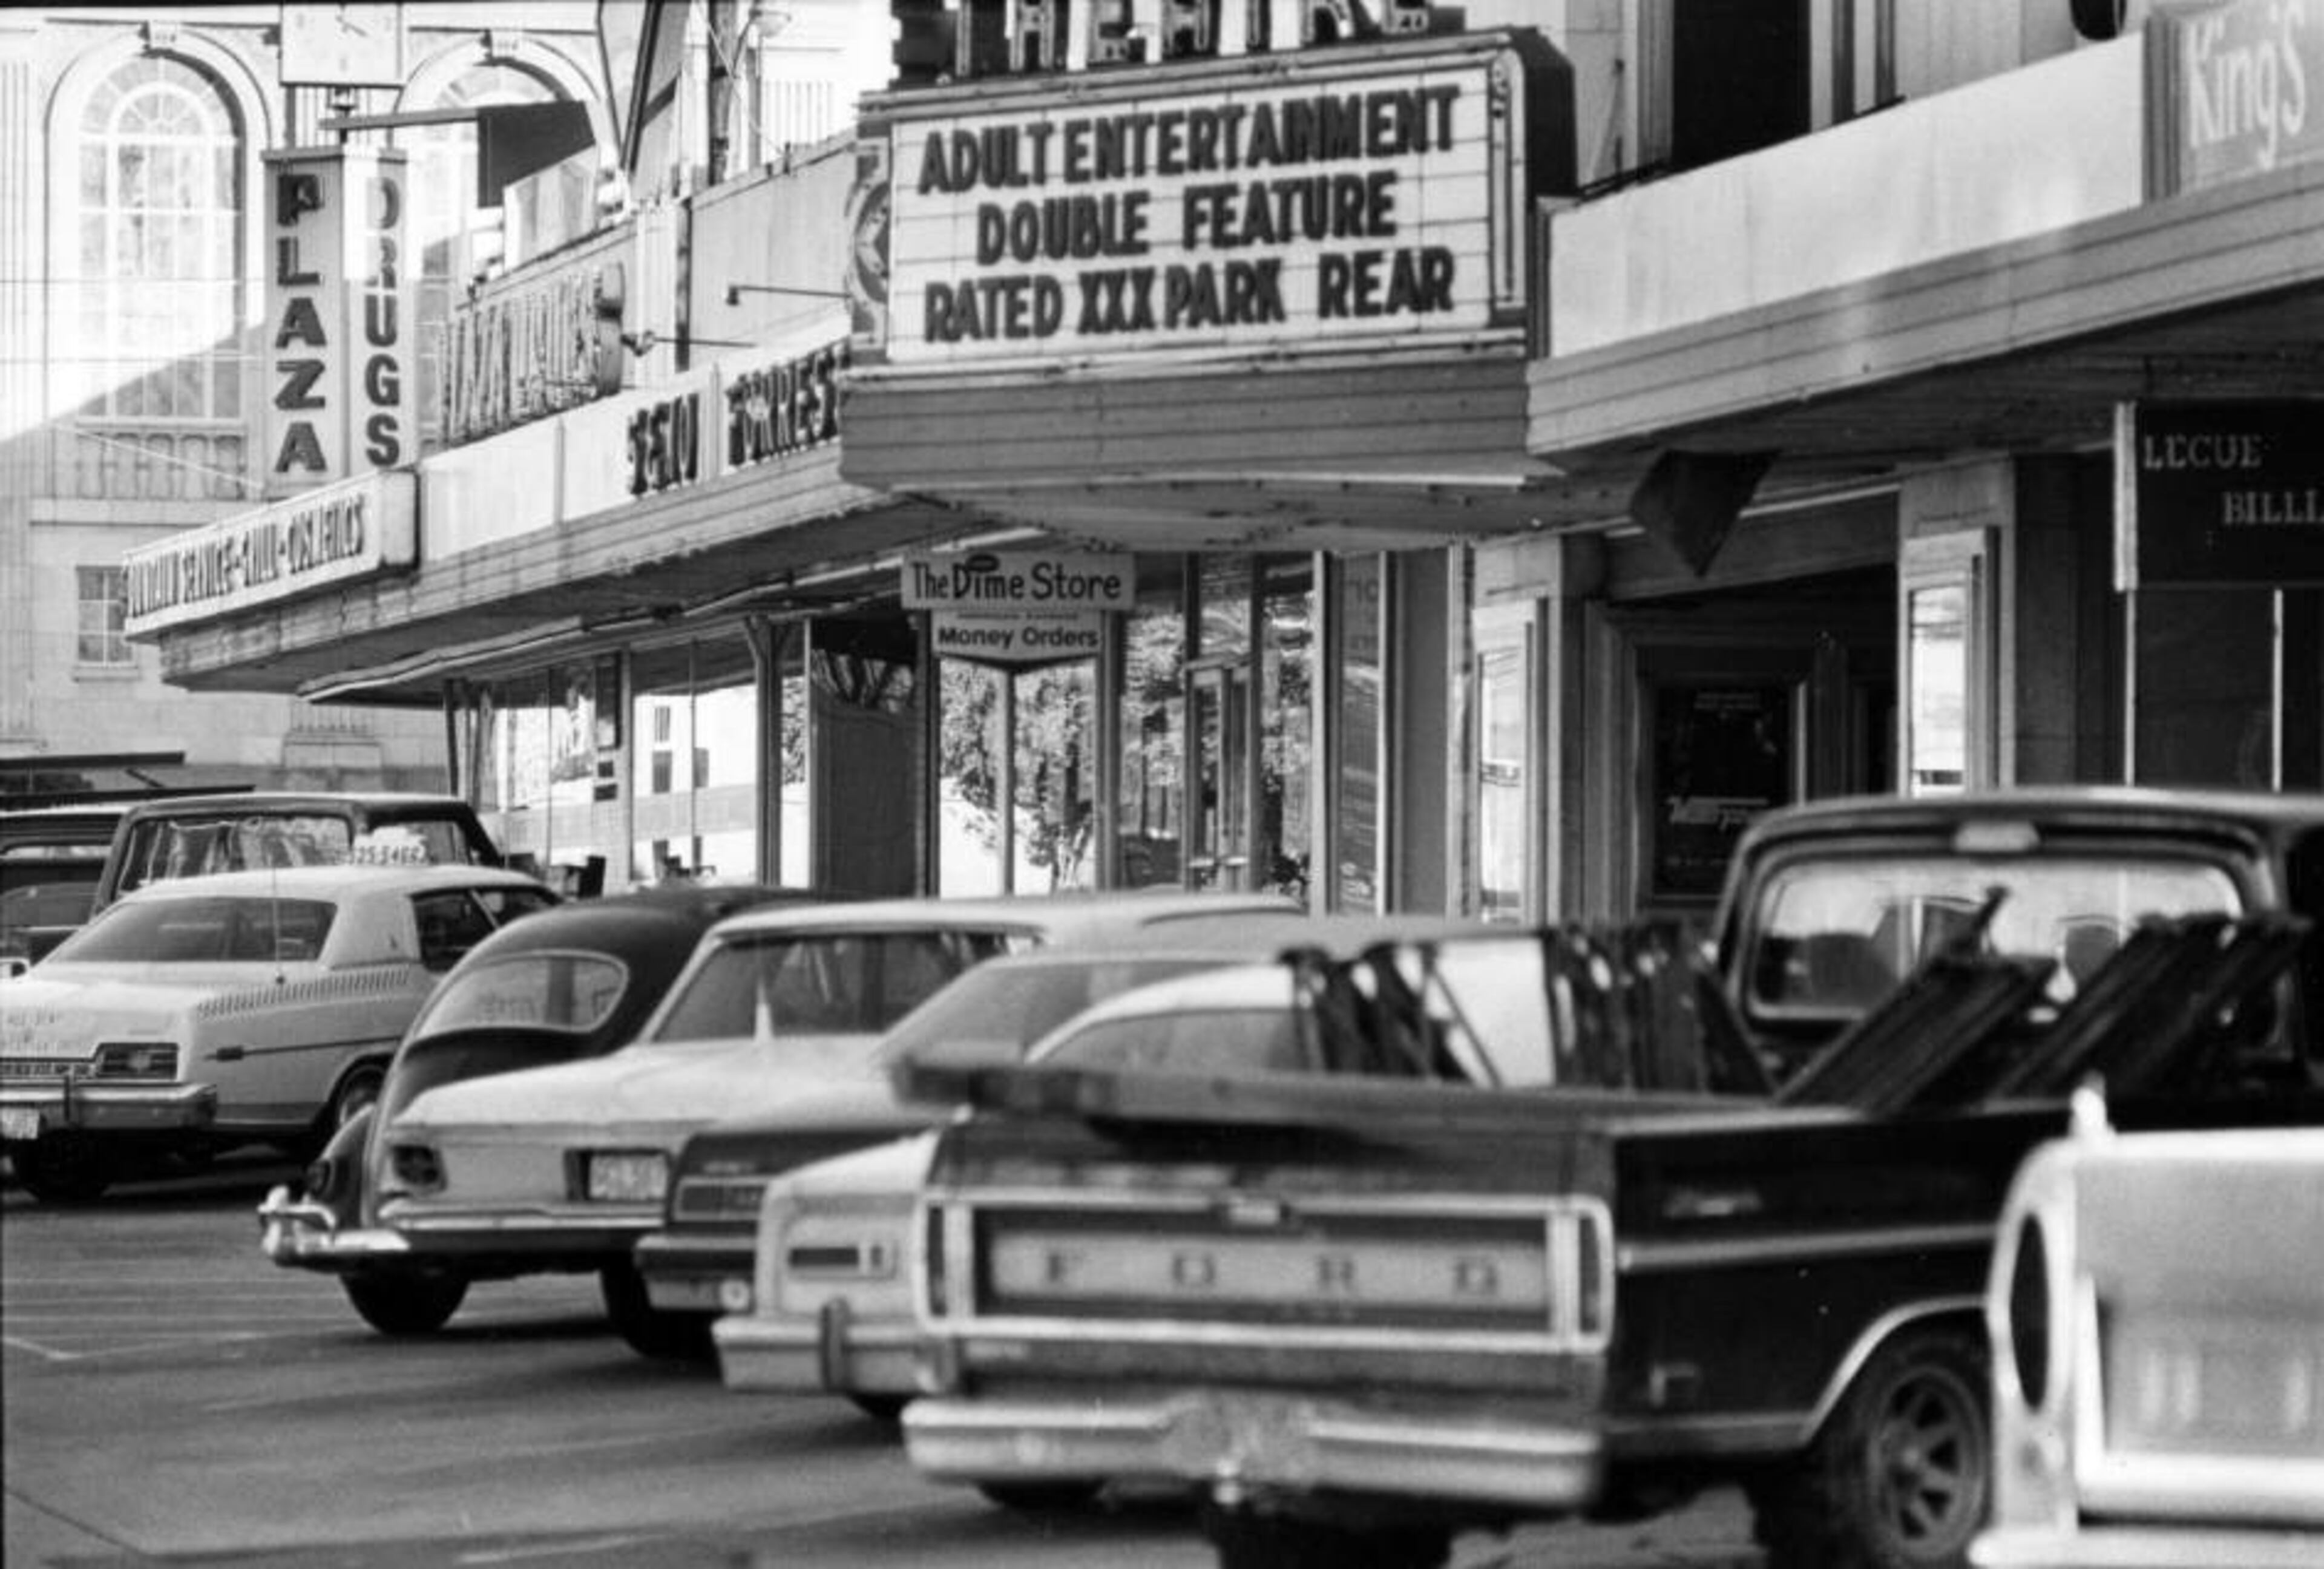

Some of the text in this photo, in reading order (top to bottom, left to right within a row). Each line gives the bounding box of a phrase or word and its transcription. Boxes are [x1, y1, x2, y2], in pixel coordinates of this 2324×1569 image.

[917, 84, 1460, 195] ADULT ENTERTAINMENT
[977, 170, 1397, 266] DOUBLE FEATURE
[274, 174, 327, 473] PLAZA
[364, 177, 401, 468] DRUGS
[925, 246, 1455, 344] RATED XXX PARK REAR
[2223, 490, 2324, 525] BILLI
[911, 553, 1121, 600] The Dime Store
[939, 626, 1098, 650] Money Orders
[1047, 1250, 1498, 1296] FORD
